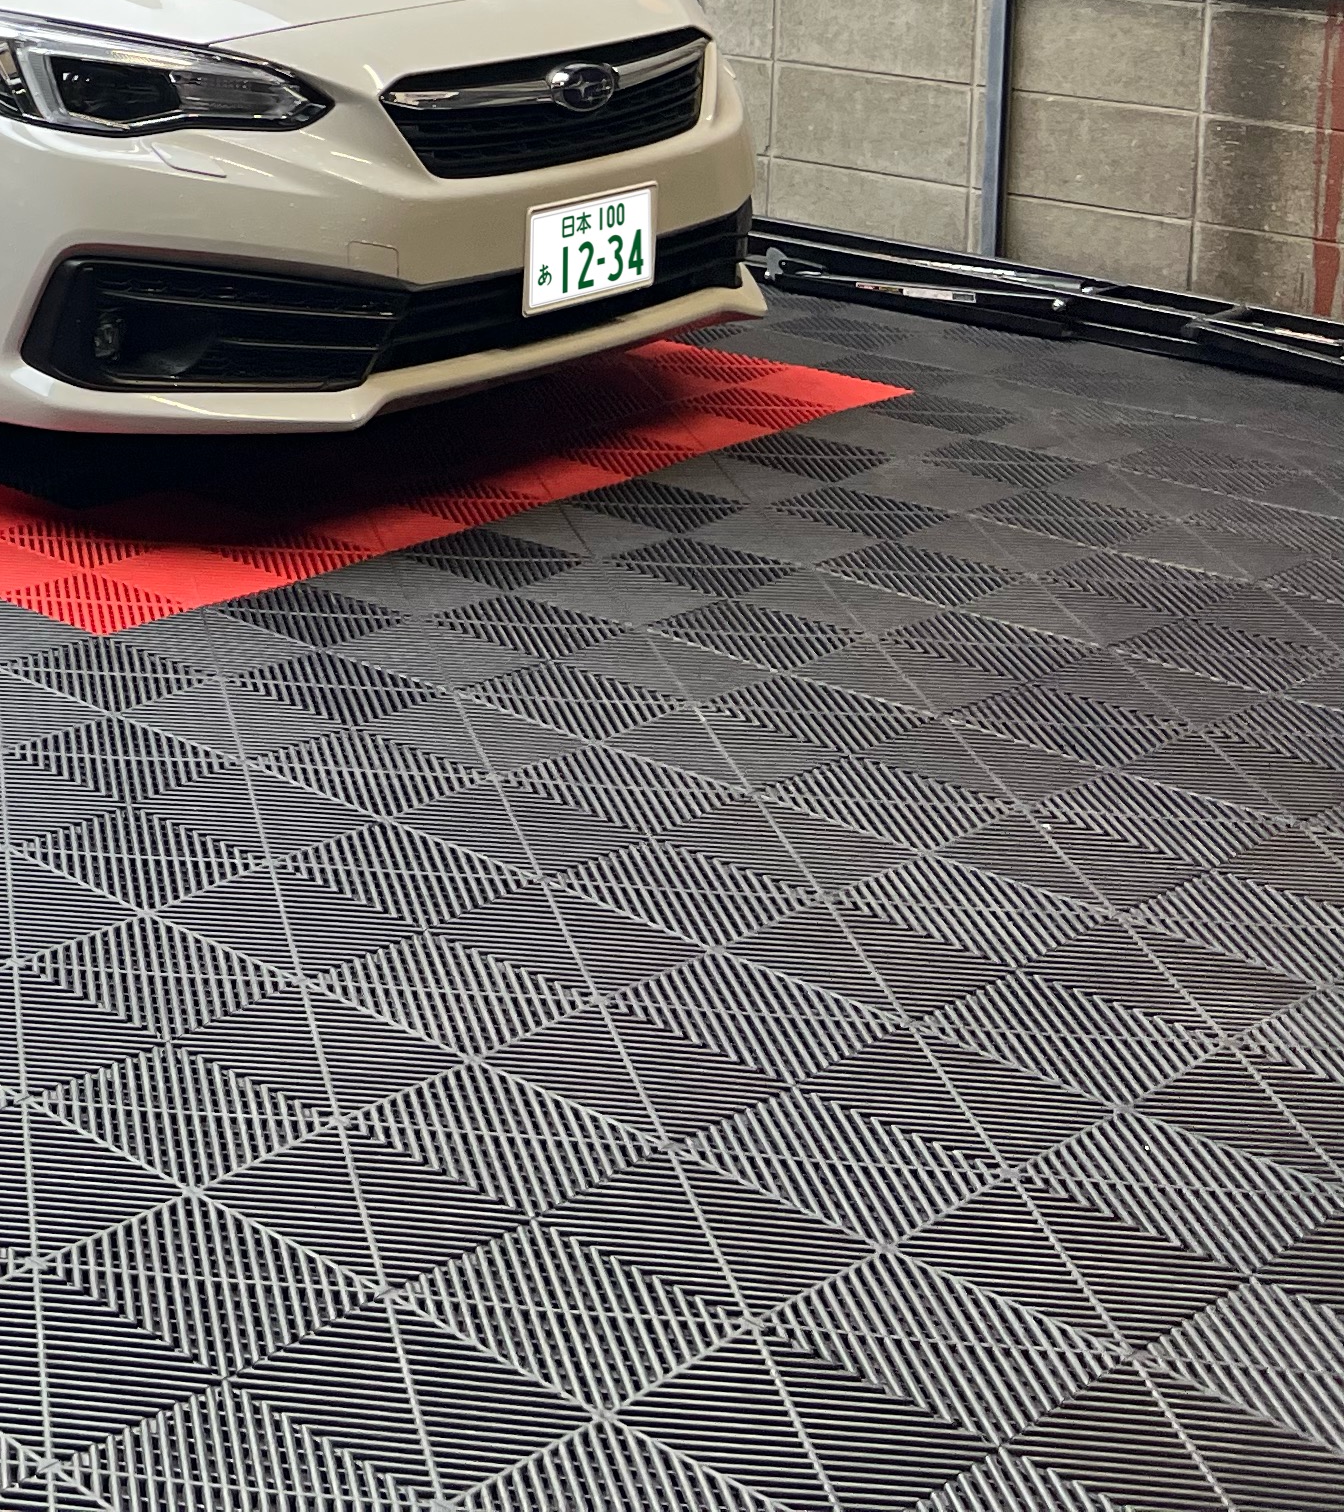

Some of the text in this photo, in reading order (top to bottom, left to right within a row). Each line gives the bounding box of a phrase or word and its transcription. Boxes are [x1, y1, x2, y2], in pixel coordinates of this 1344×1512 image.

[562, 203, 625, 239] 日本 100
[537, 229, 644, 294] あ 12-34
